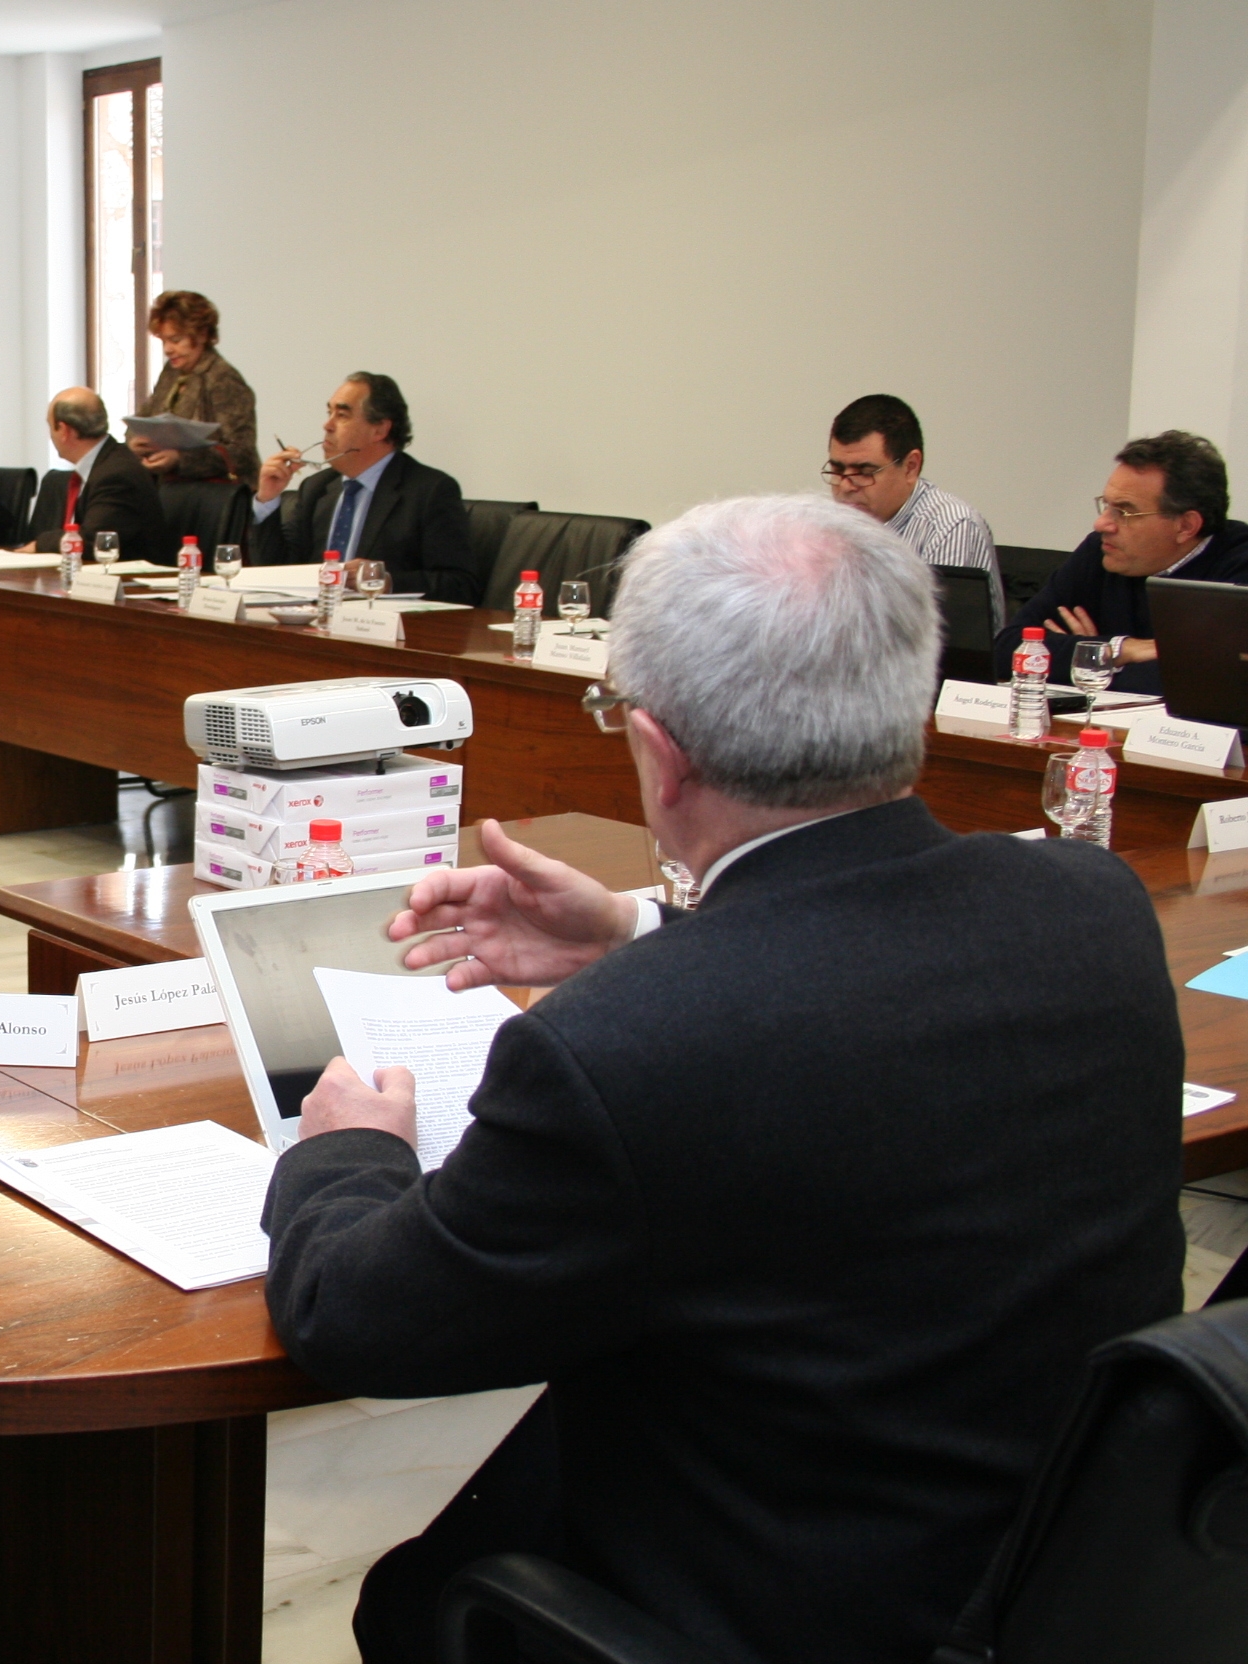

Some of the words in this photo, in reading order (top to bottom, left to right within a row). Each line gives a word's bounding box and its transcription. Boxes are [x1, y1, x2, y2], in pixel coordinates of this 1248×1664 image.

[301, 716, 327, 726] EPSON
[1159, 726, 1191, 739] Eduardo
[1148, 735, 1179, 748] Montero
[288, 798, 311, 808] xerox
[284, 839, 307, 849] xerox
[114, 992, 148, 1010] Jesús
[150, 989, 189, 1003] López
[191, 982, 218, 996] Pala
